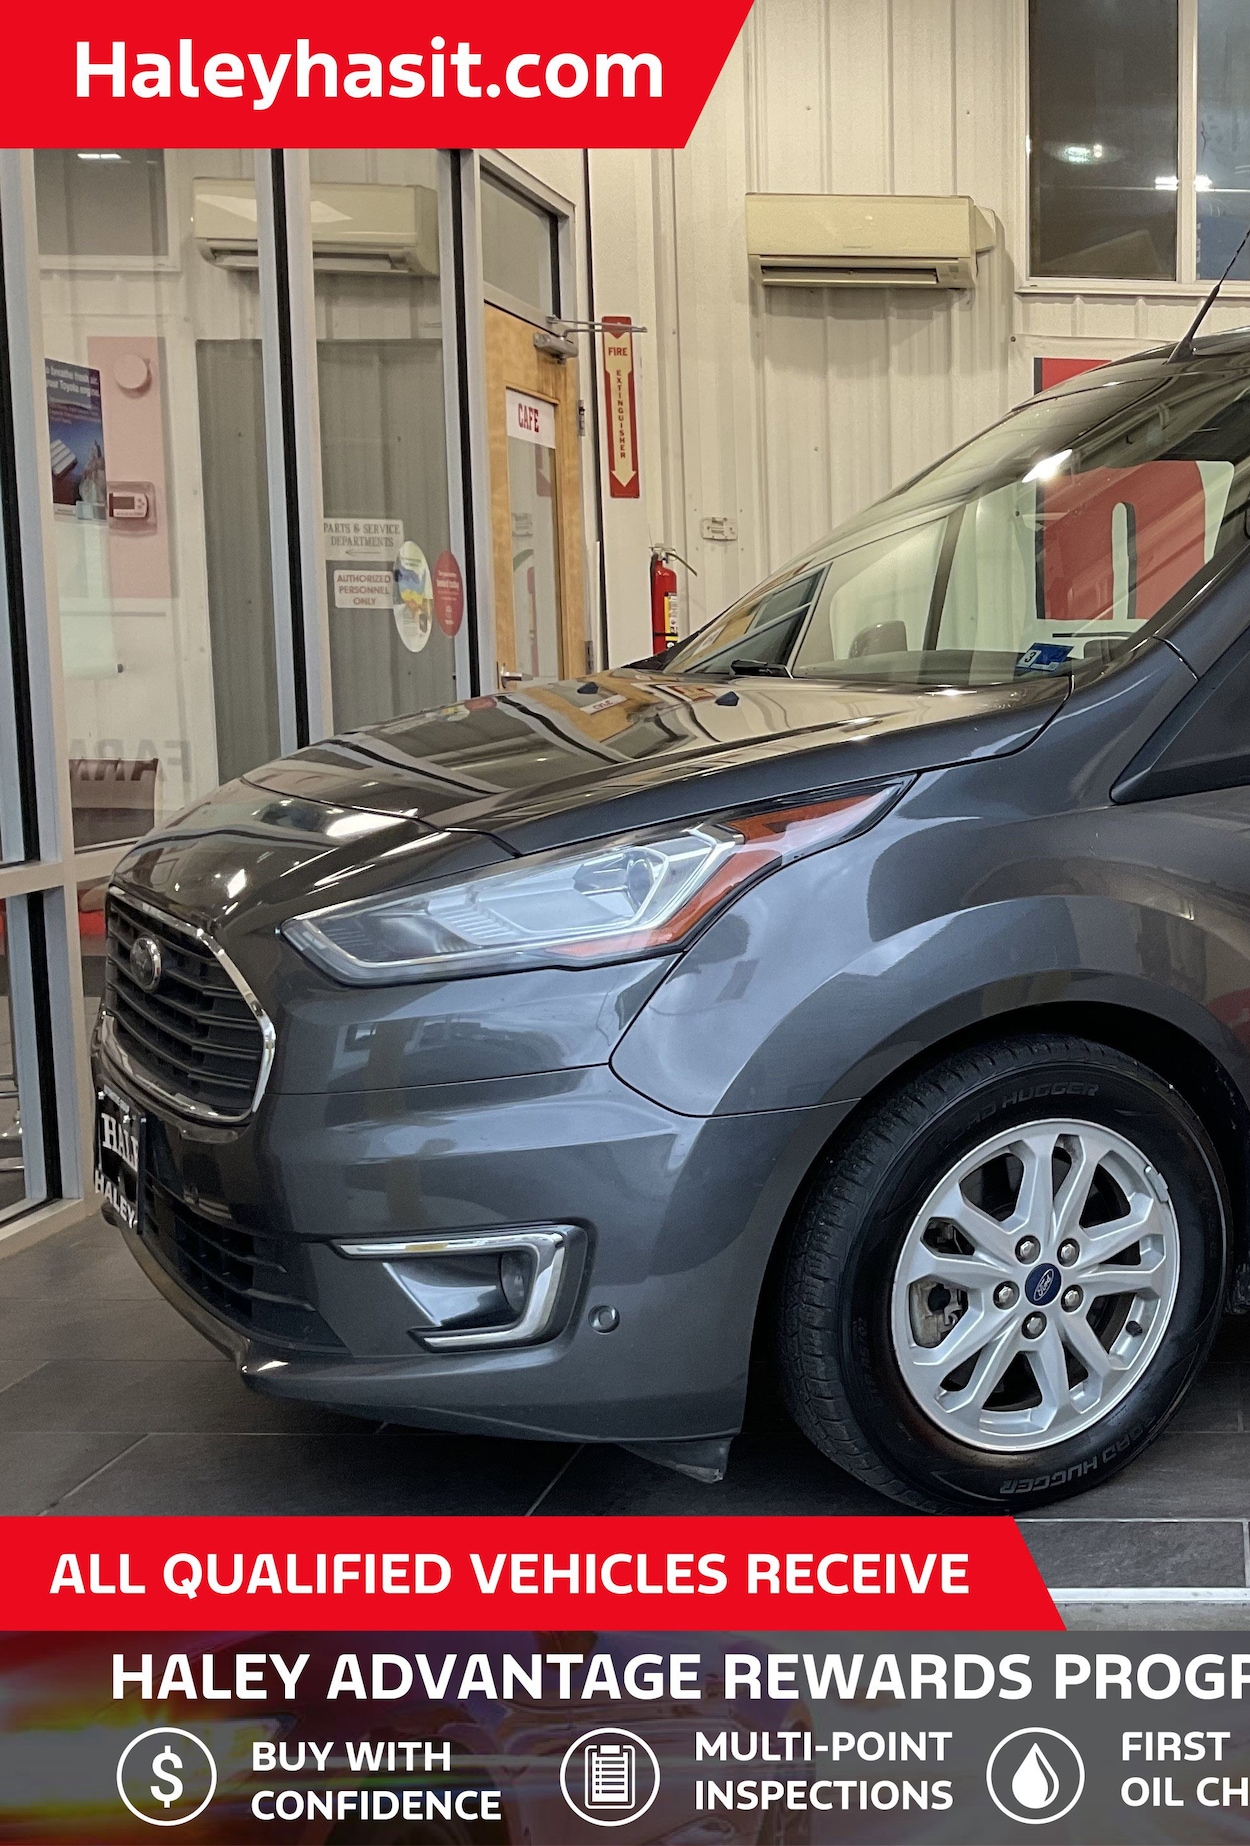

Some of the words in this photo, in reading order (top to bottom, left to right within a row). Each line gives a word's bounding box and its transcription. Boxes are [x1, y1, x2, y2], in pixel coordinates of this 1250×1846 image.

[608, 347, 628, 356] FIRE
[518, 403, 540, 432] CAFE
[616, 370, 626, 459] EXTINGUISHER
[323, 522, 351, 534] PARTS
[353, 523, 361, 534] &
[363, 523, 400, 535] SERVICE
[330, 536, 394, 547] DEPARTMENTS
[336, 574, 391, 583] AUTHORIZED
[338, 586, 390, 595] PERSONNEL
[353, 597, 376, 605] ONLY
[1001, 1081, 1099, 1109] HUGGER
[94, 1169, 135, 1229] HALEY
[999, 1455, 1099, 1495] HUGGER
